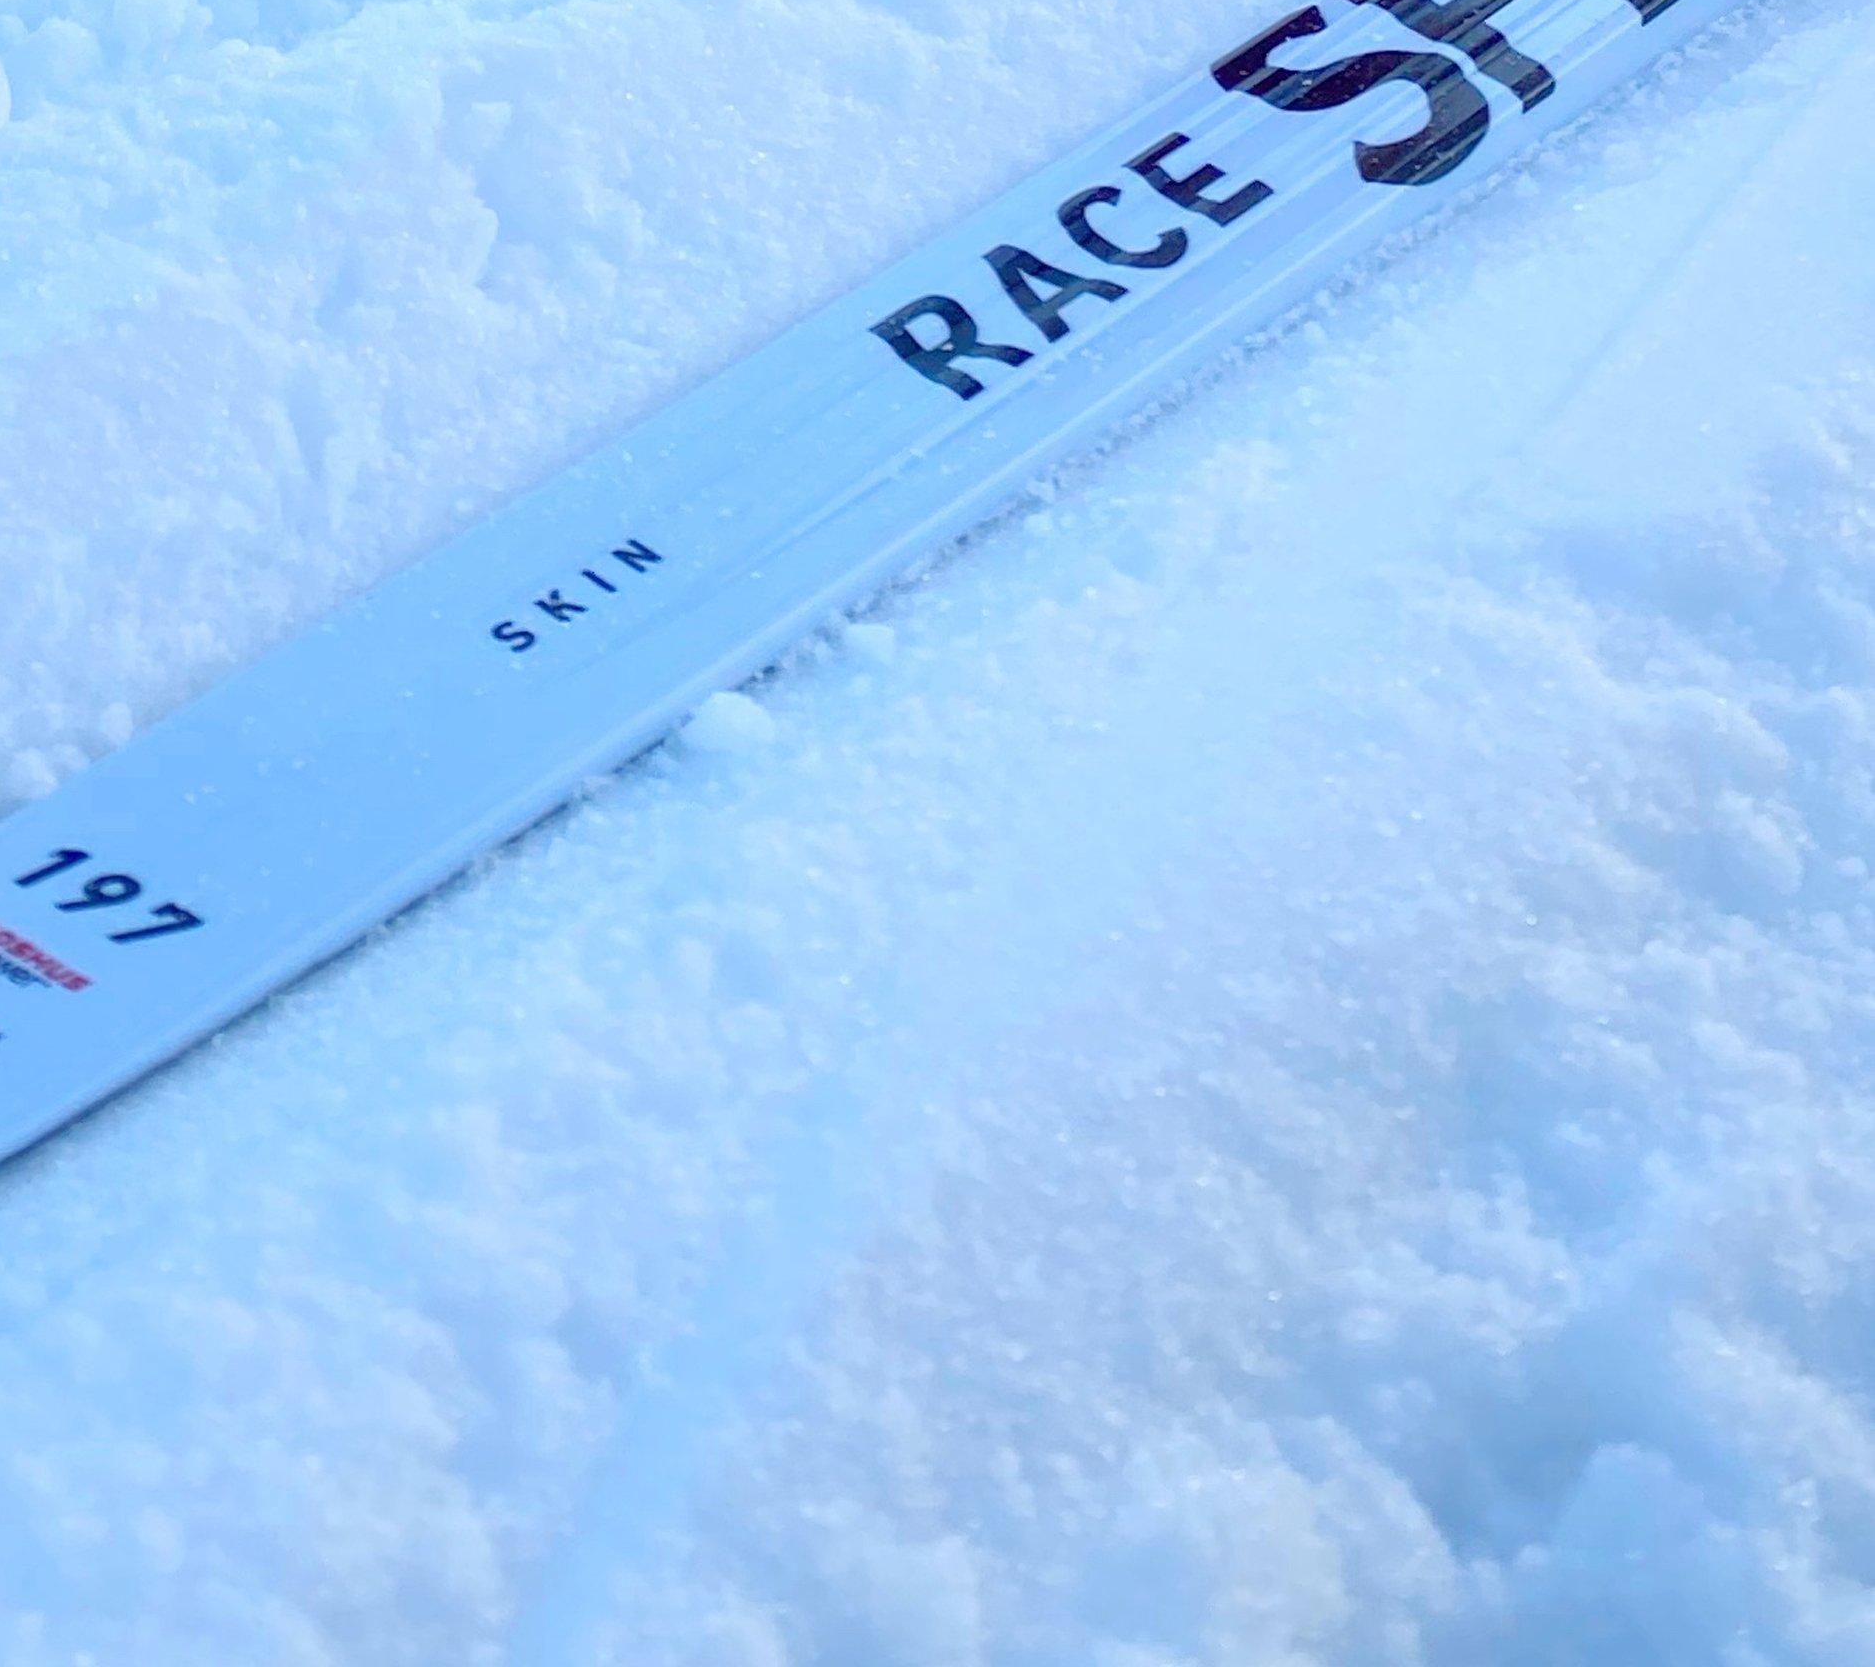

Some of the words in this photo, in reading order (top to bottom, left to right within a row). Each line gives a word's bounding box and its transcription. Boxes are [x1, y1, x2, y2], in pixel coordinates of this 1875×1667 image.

[869, 131, 1274, 401] RACE
[491, 539, 664, 653] SKIN
[14, 847, 206, 945] 197
